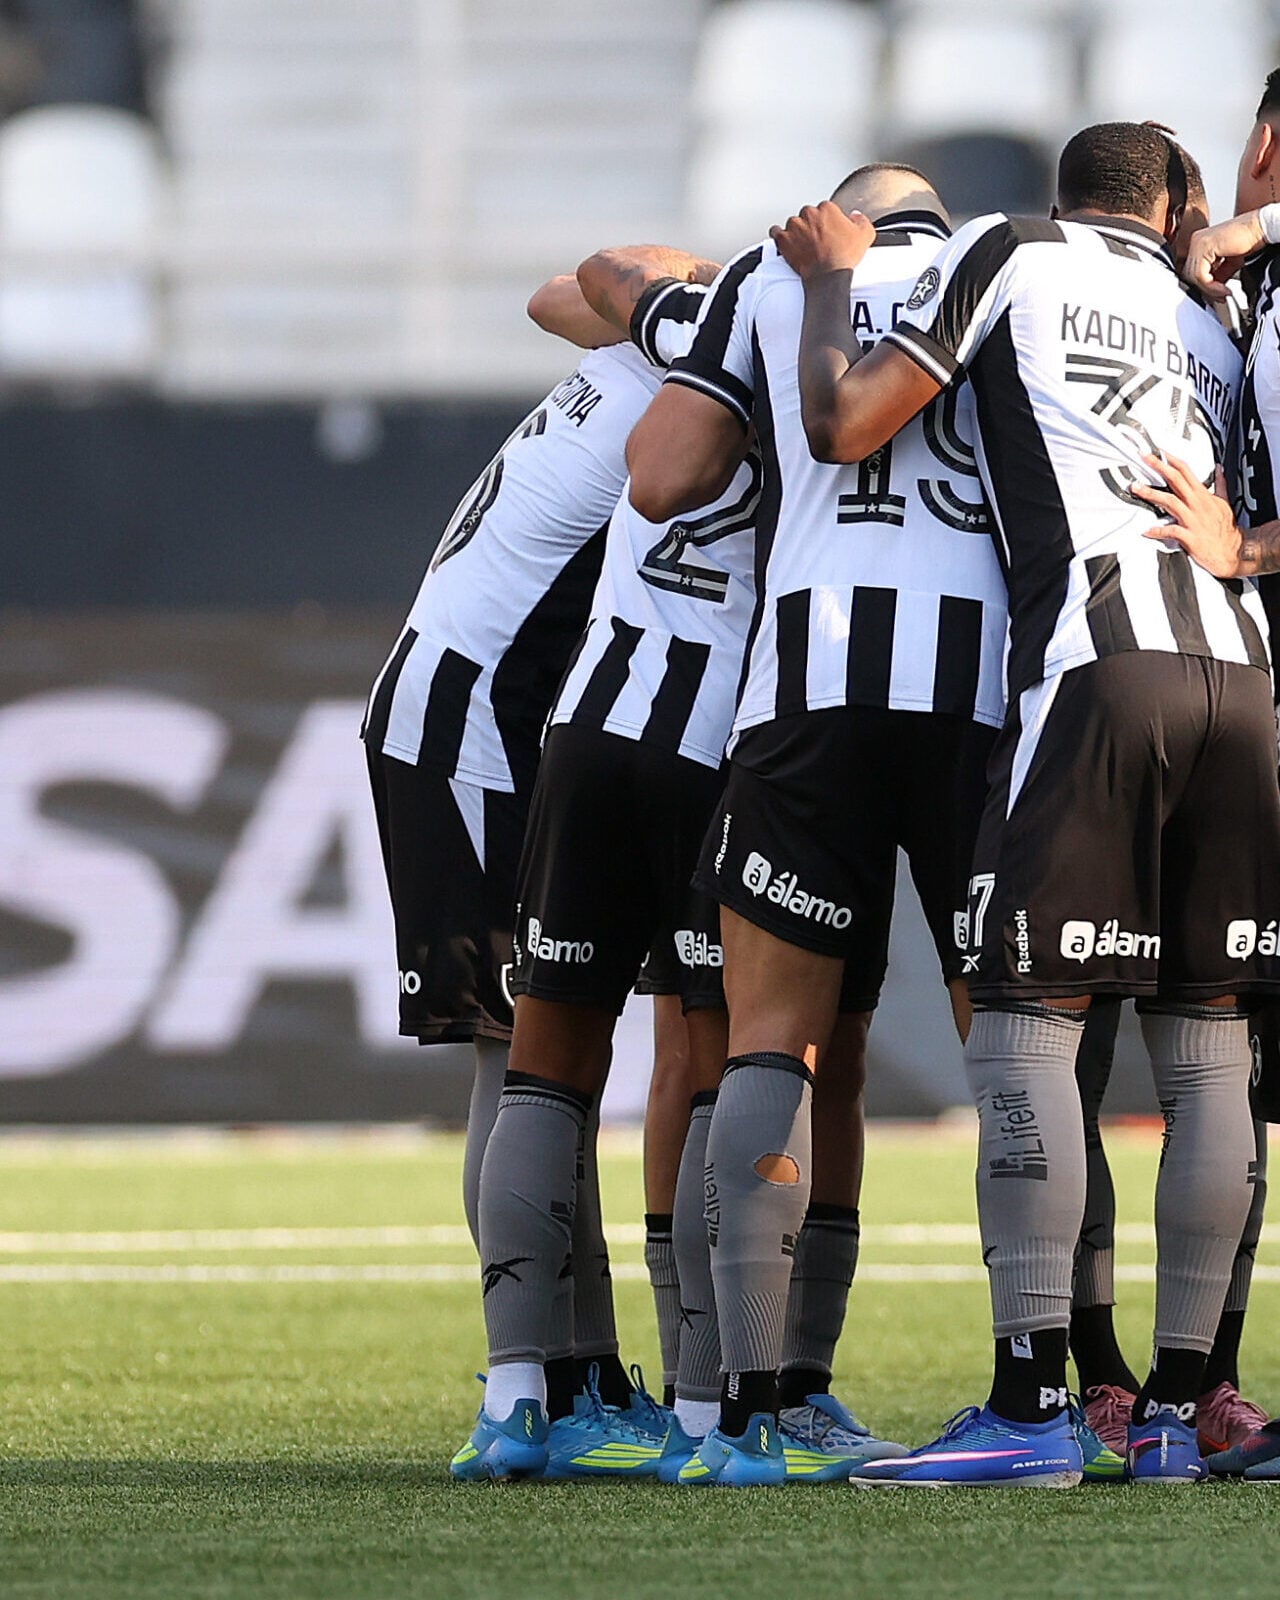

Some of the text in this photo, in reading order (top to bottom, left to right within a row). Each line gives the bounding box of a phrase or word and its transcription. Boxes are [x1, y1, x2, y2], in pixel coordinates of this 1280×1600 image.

[767, 871, 852, 929] álamo
[968, 873, 995, 948] 7
[694, 932, 724, 968] ála
[1014, 909, 1033, 973] Reebok
[1095, 919, 1160, 960] álam
